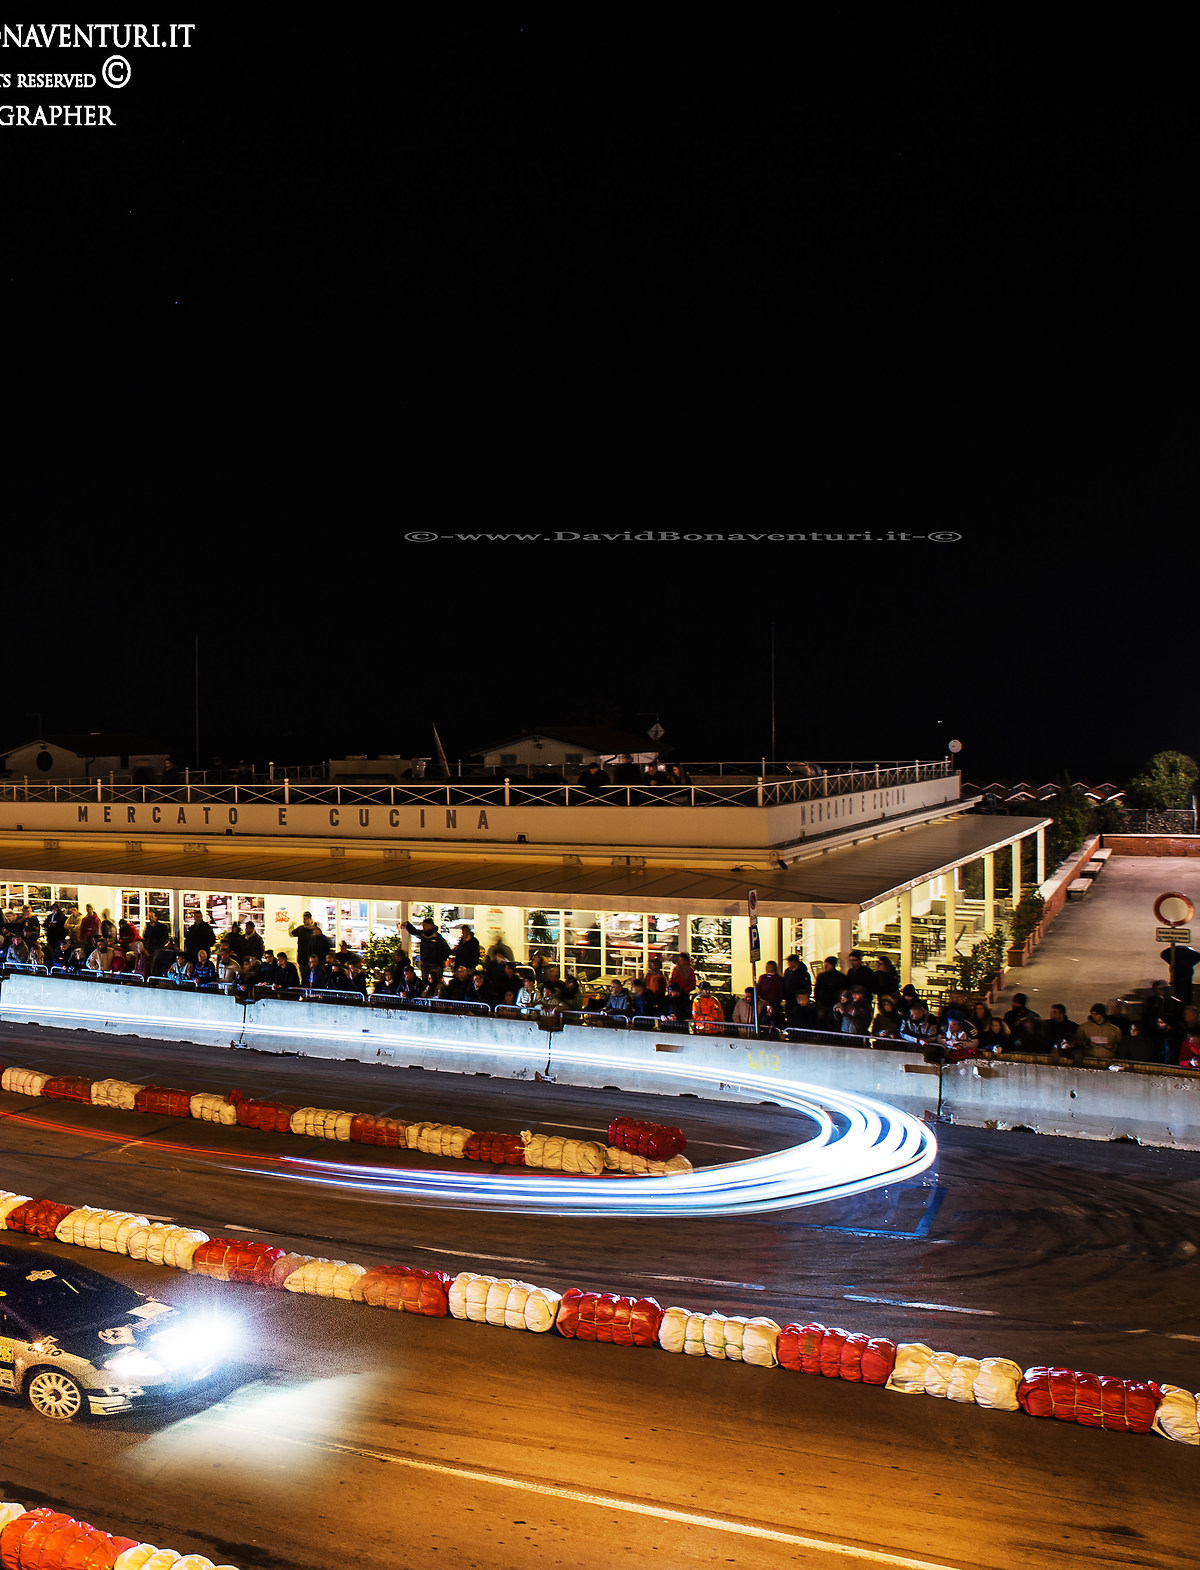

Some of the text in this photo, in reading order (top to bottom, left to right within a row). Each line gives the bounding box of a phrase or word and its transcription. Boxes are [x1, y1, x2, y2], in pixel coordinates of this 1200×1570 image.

[78, 805, 491, 830] MERCATO E CUCINA
[800, 788, 906, 825] MERCATO E CUCINA
[751, 929, 758, 948] P
